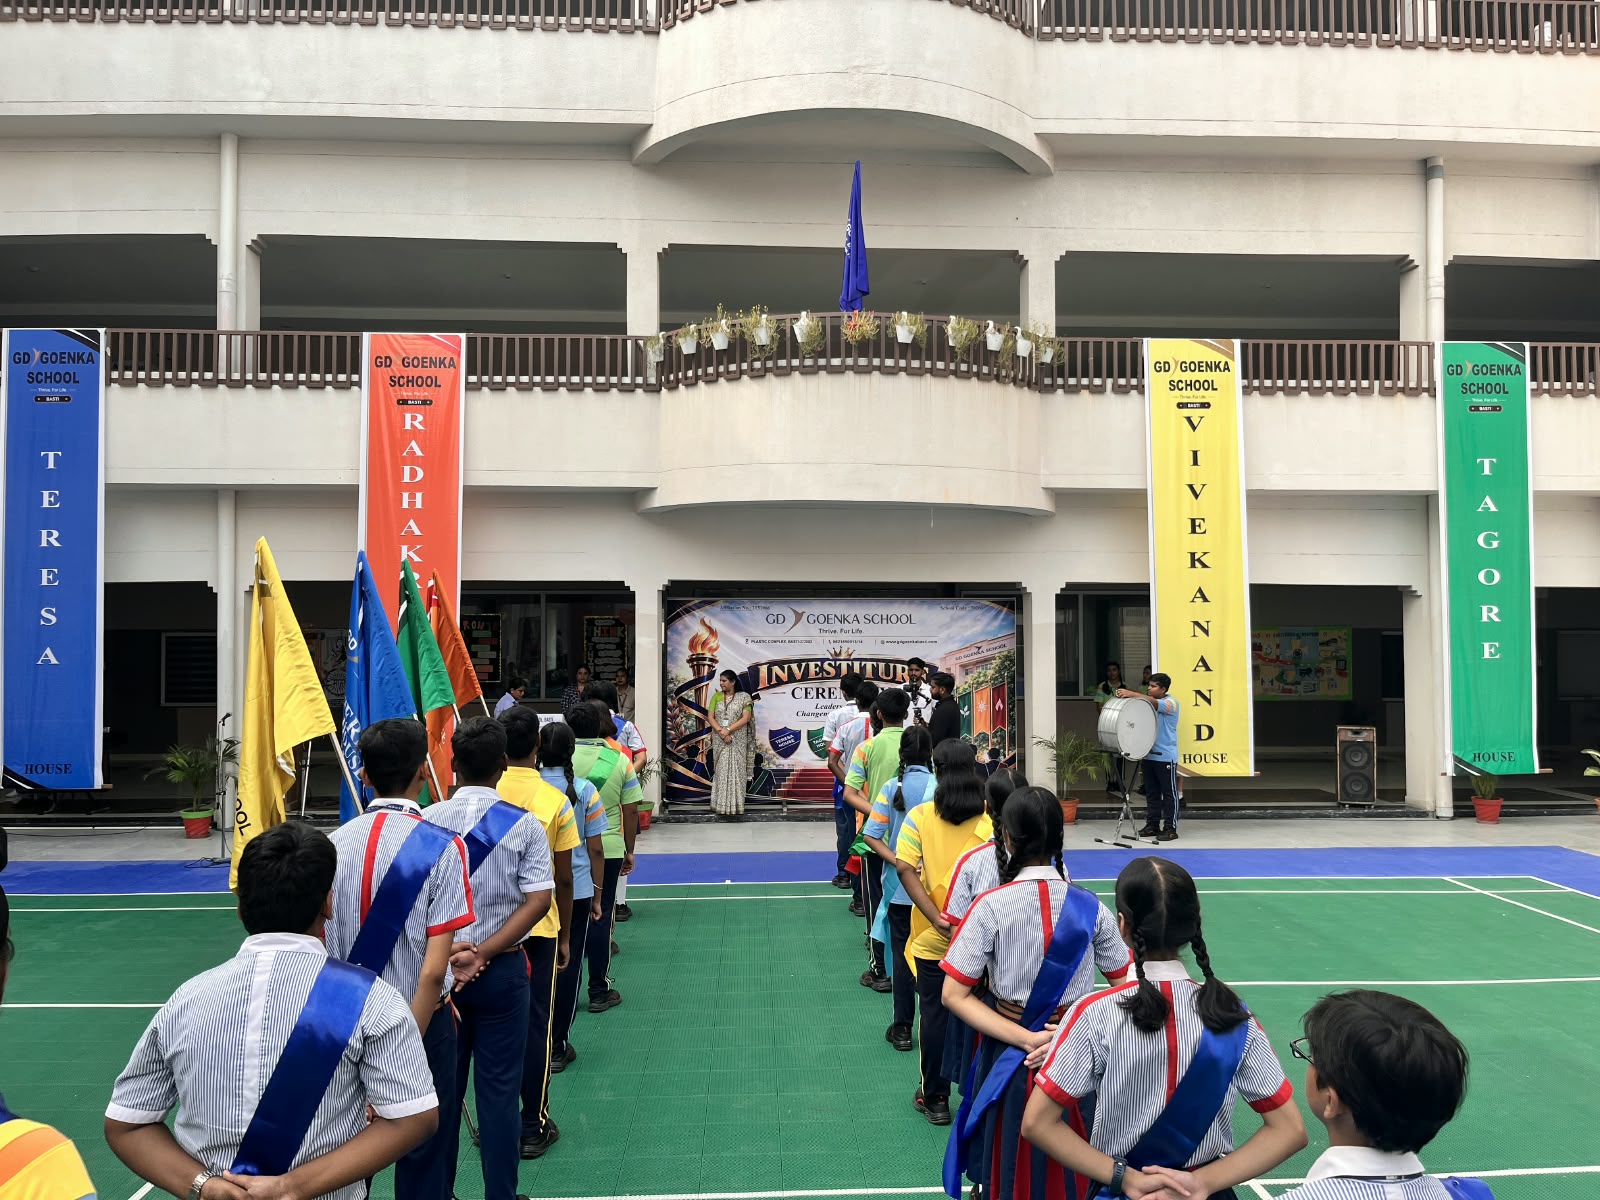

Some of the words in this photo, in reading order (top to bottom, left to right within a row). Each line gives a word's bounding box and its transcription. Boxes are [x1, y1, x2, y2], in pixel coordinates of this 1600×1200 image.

[12, 351, 31, 365] GD
[40, 351, 95, 365] GOENKA
[374, 355, 393, 368] GD
[401, 355, 457, 369] GOENKA
[1153, 360, 1171, 373] GD
[1179, 360, 1231, 373] GOENKA
[1447, 363, 1463, 376] GD
[1471, 363, 1522, 376] GOENKA
[26, 371, 80, 385] SCHOOL
[389, 375, 442, 388] SCHOOL
[1168, 379, 1218, 391] SCHOOL
[1460, 382, 1509, 395] SCHOOL
[36, 451, 63, 666] TERESA
[1476, 458, 1502, 660] TAGORE
[1183, 416, 1215, 742] VIVEKANAND
[765, 613, 786, 625] GD
[806, 613, 860, 625] GOENKA
[863, 613, 917, 625] SCHOOL
[963, 650, 985, 659] GOENKA
[985, 643, 1008, 652] SCHOOL
[791, 686, 842, 700] CERE
[1182, 752, 1228, 765] HOUSE
[1472, 751, 1516, 763] HOUSE
[24, 763, 73, 775] HOUSE
